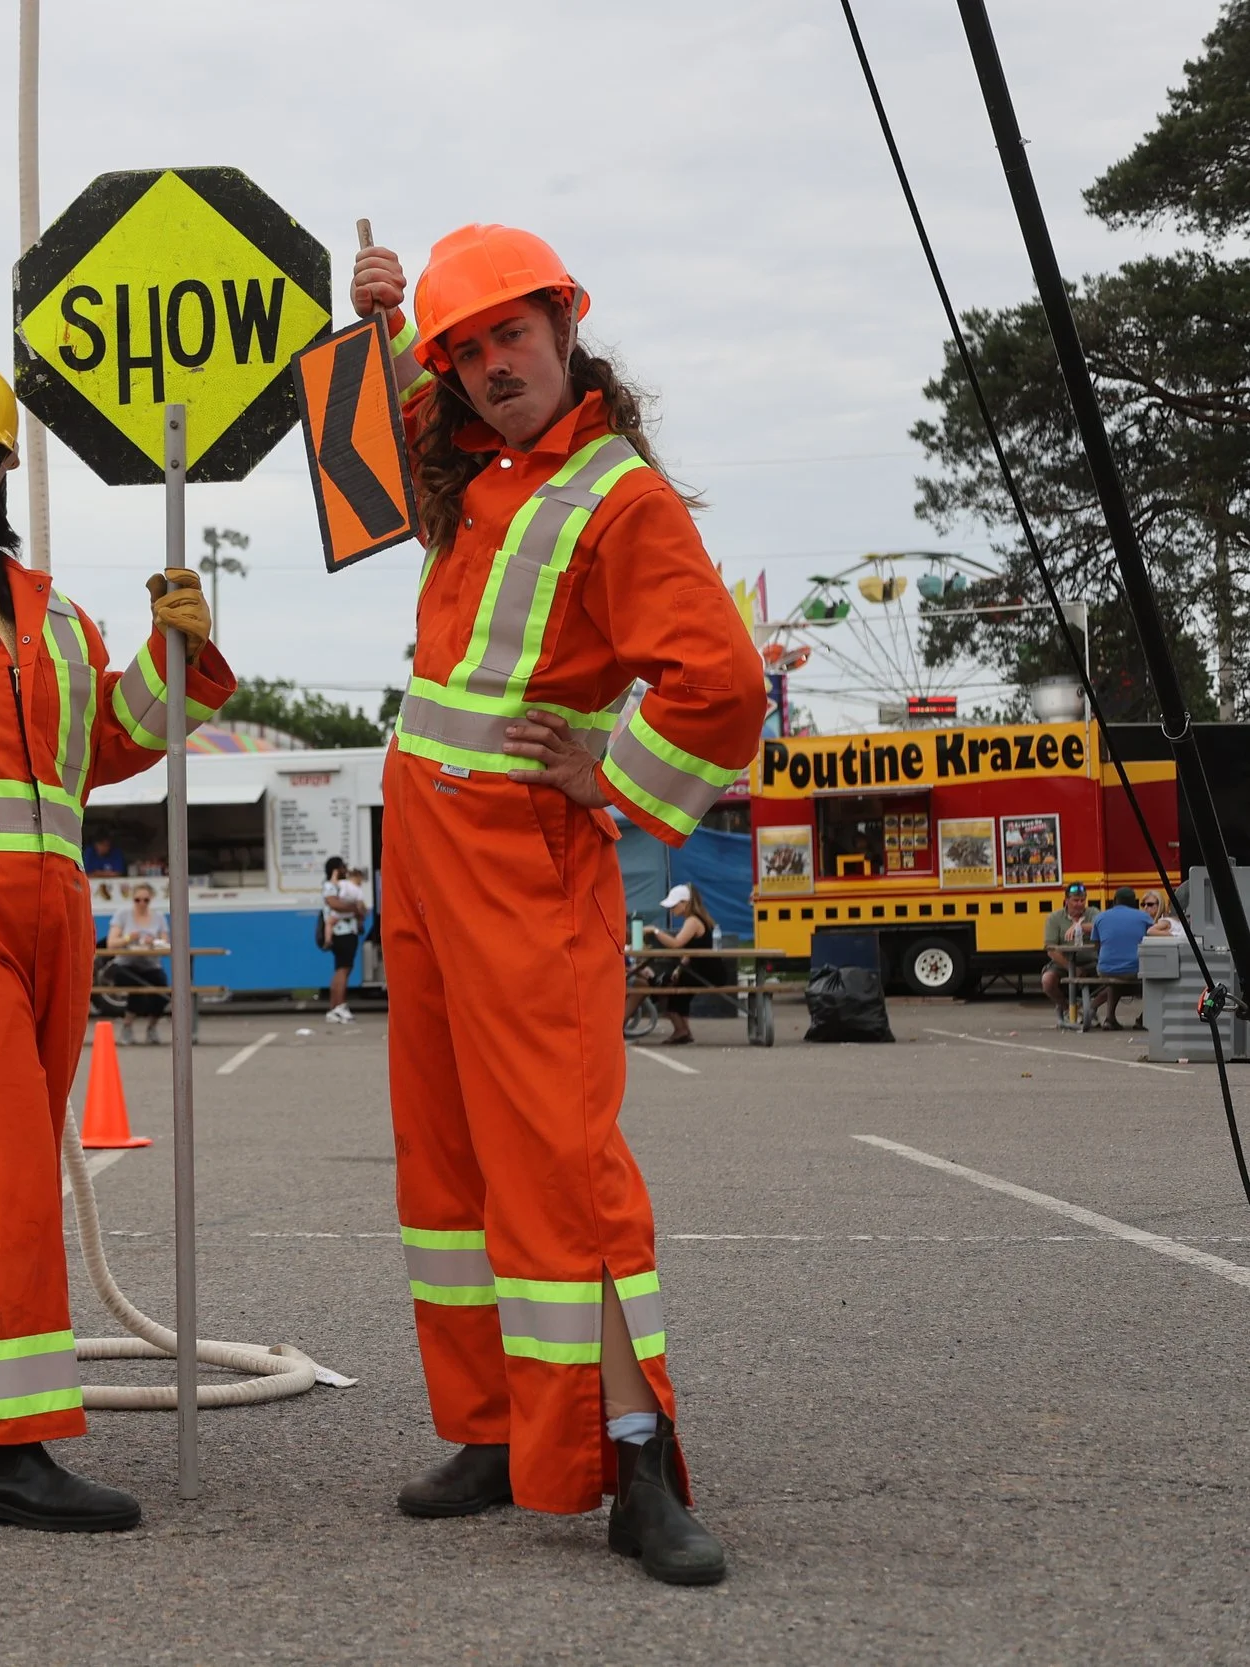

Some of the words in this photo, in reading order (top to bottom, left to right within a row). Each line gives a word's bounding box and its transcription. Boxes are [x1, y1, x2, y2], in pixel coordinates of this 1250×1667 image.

[58, 277, 286, 405] SHOW
[763, 739, 924, 788] Poutine
[936, 733, 1084, 778] Krazee
